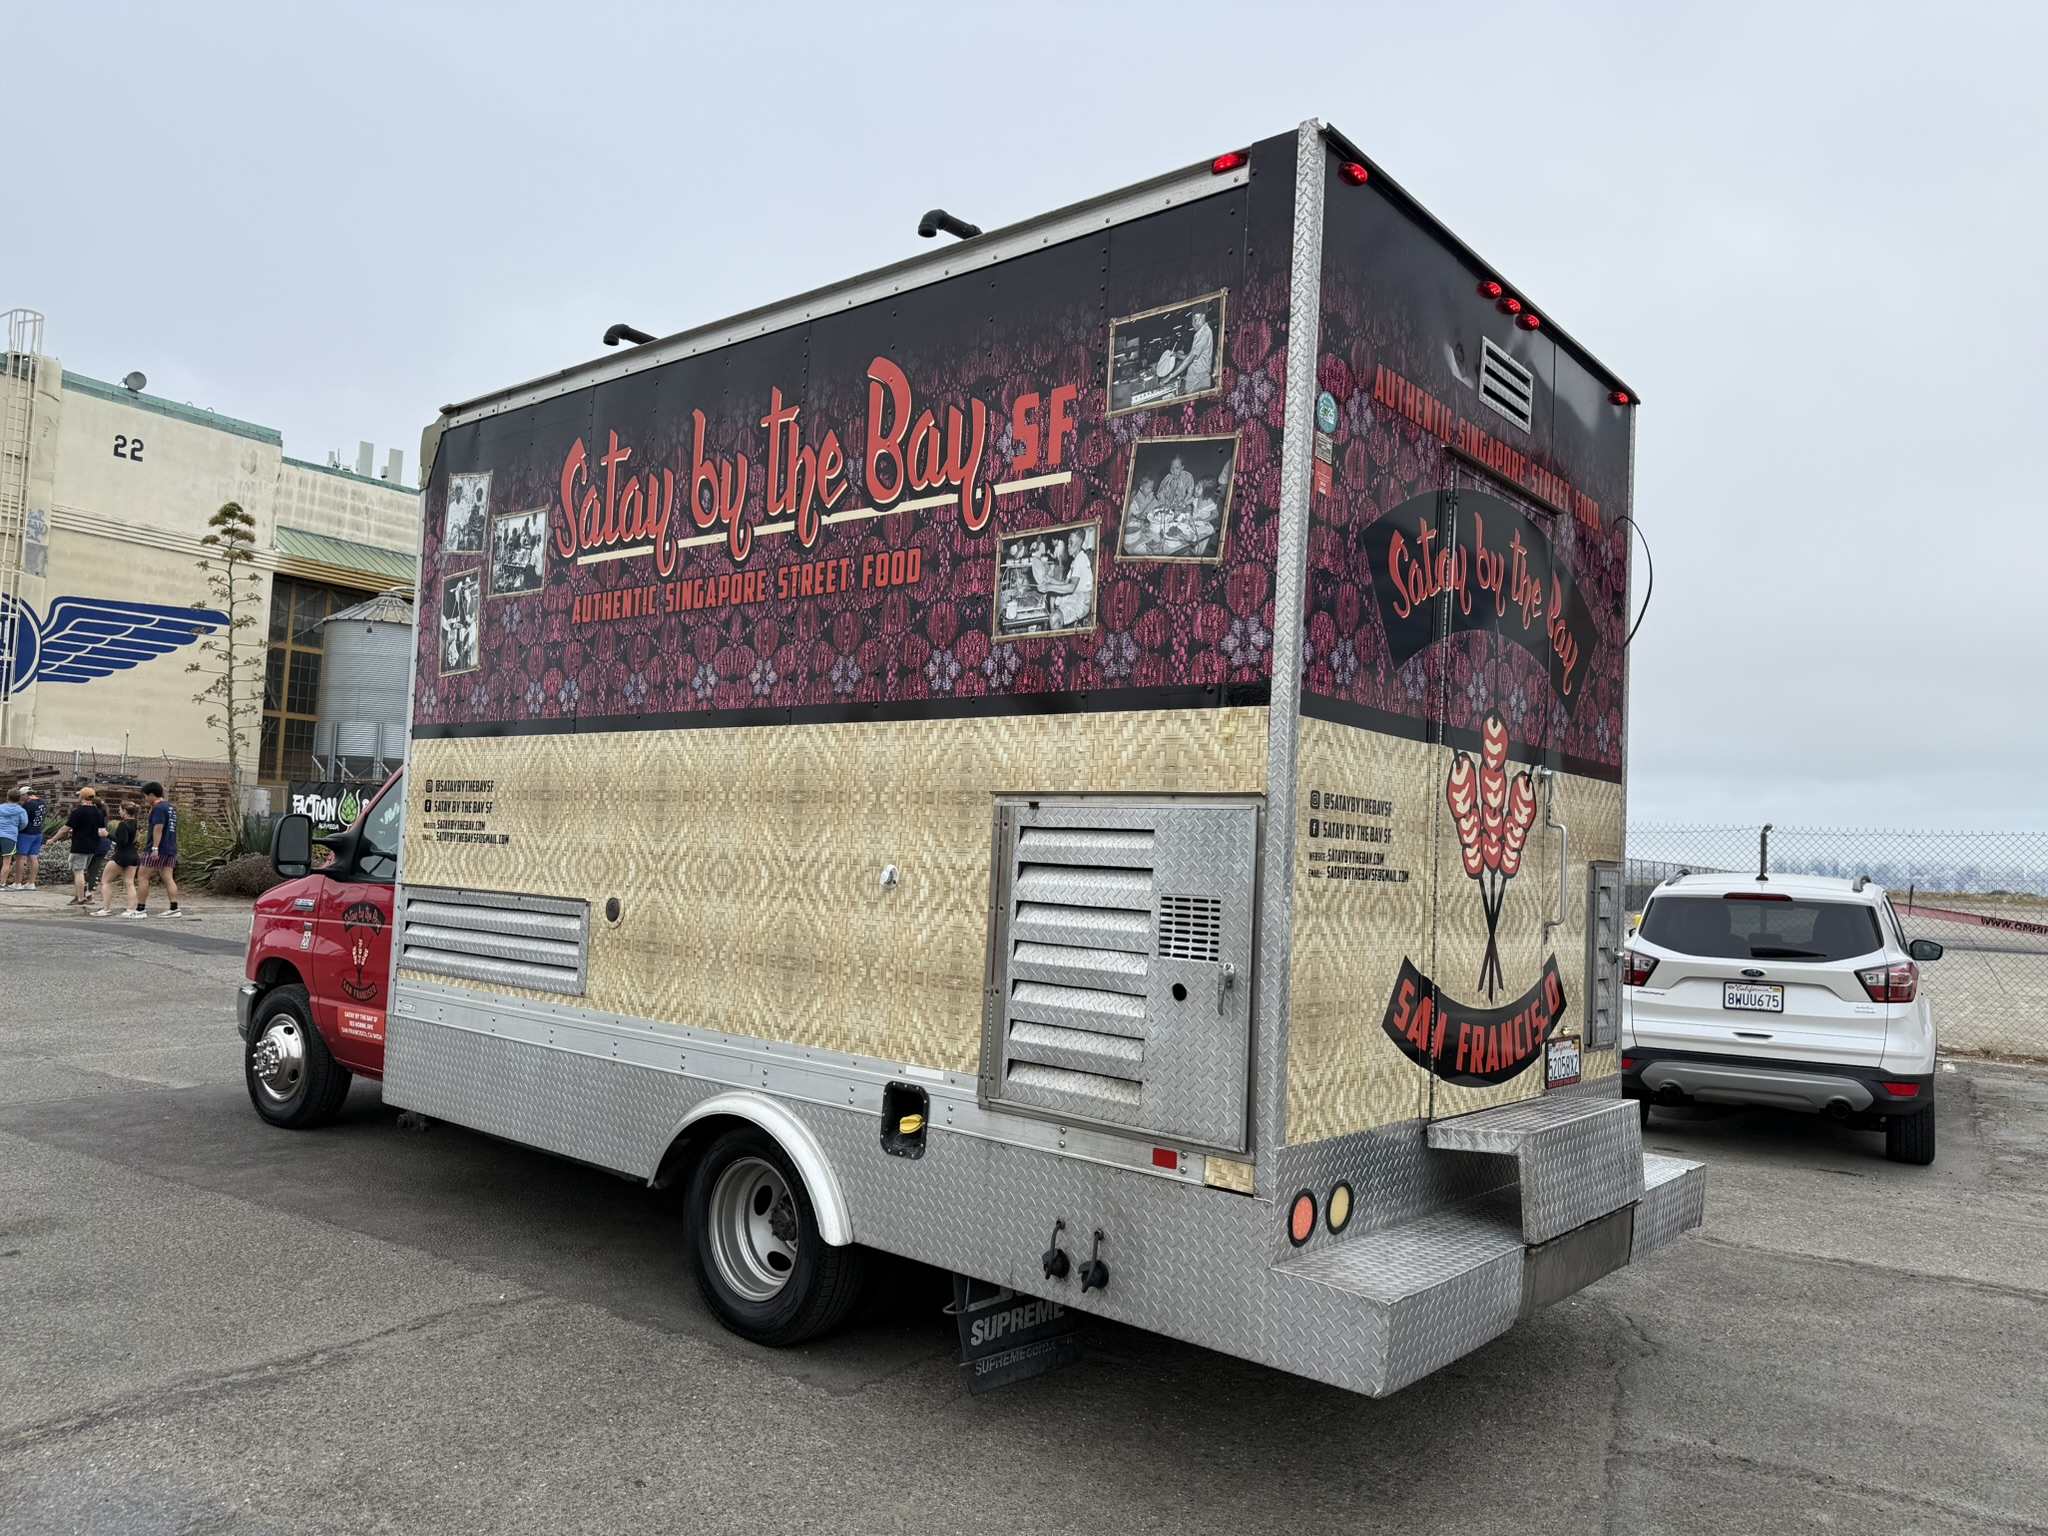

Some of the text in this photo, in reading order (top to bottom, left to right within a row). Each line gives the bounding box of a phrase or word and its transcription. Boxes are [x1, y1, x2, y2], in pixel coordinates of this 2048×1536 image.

[113, 434, 144, 462] 22
[1374, 363, 1599, 531] AUTHENTIC SINGAPORE STREET FOOD
[555, 357, 1077, 577] Satay by the Bay SF
[1389, 517, 1471, 618] Satay
[1474, 511, 1506, 617] by
[1510, 528, 1542, 630] the
[571, 548, 921, 624] AUTHENTIC SINGAPORE STREET FOOD
[435, 780, 495, 793] @SATAYBYTHEBAYSF
[293, 794, 338, 823] FACTION
[434, 800, 493, 814] SATAY BY THE BAY SF
[1323, 792, 1392, 817] @SATAYBYTHEBAYSF
[1323, 821, 1392, 844] SATAY BY THE BAY SF
[1728, 993, 1779, 1008] 8WUU675
[1393, 979, 1447, 1060] SAN
[970, 1300, 1065, 1346] SUPREME
